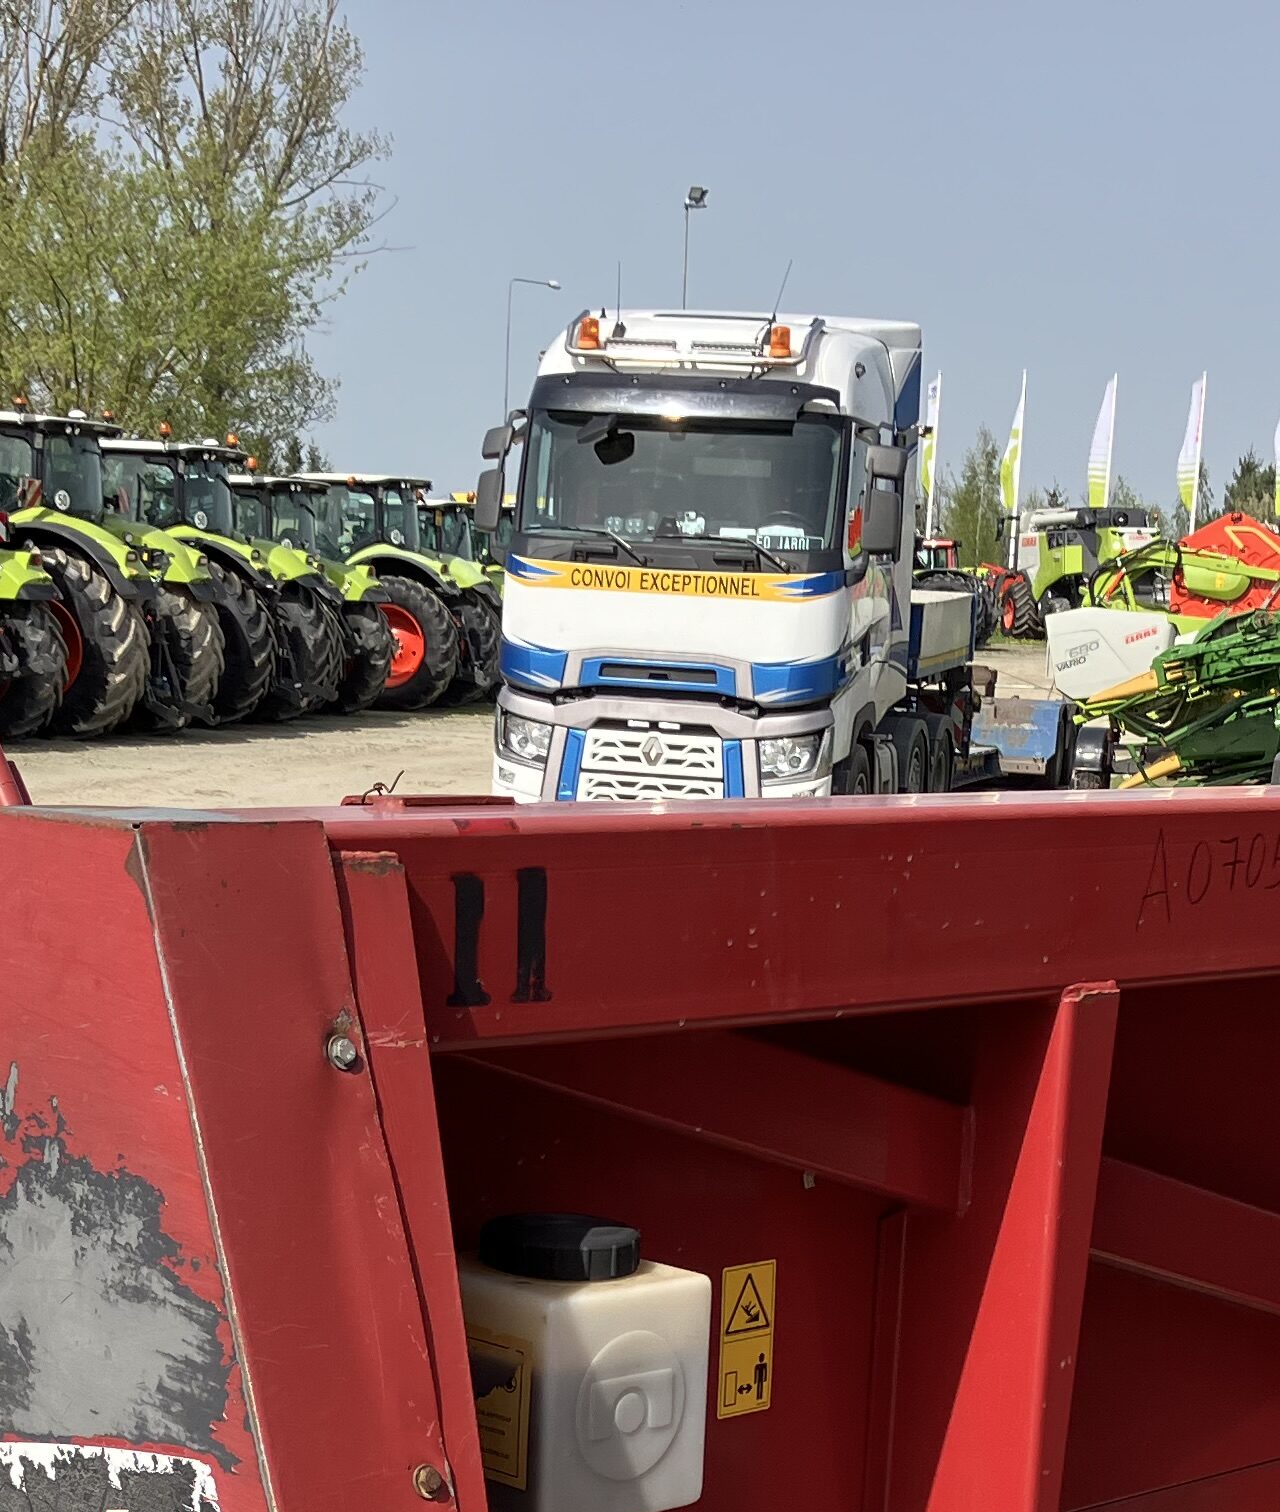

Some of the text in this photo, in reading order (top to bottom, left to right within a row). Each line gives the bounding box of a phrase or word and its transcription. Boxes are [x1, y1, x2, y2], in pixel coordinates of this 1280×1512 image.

[571, 568, 760, 597] CONVOI EXCEPTIONNEL
[1124, 627, 1158, 645] CLAAS
[1055, 656, 1087, 672] VARIO
